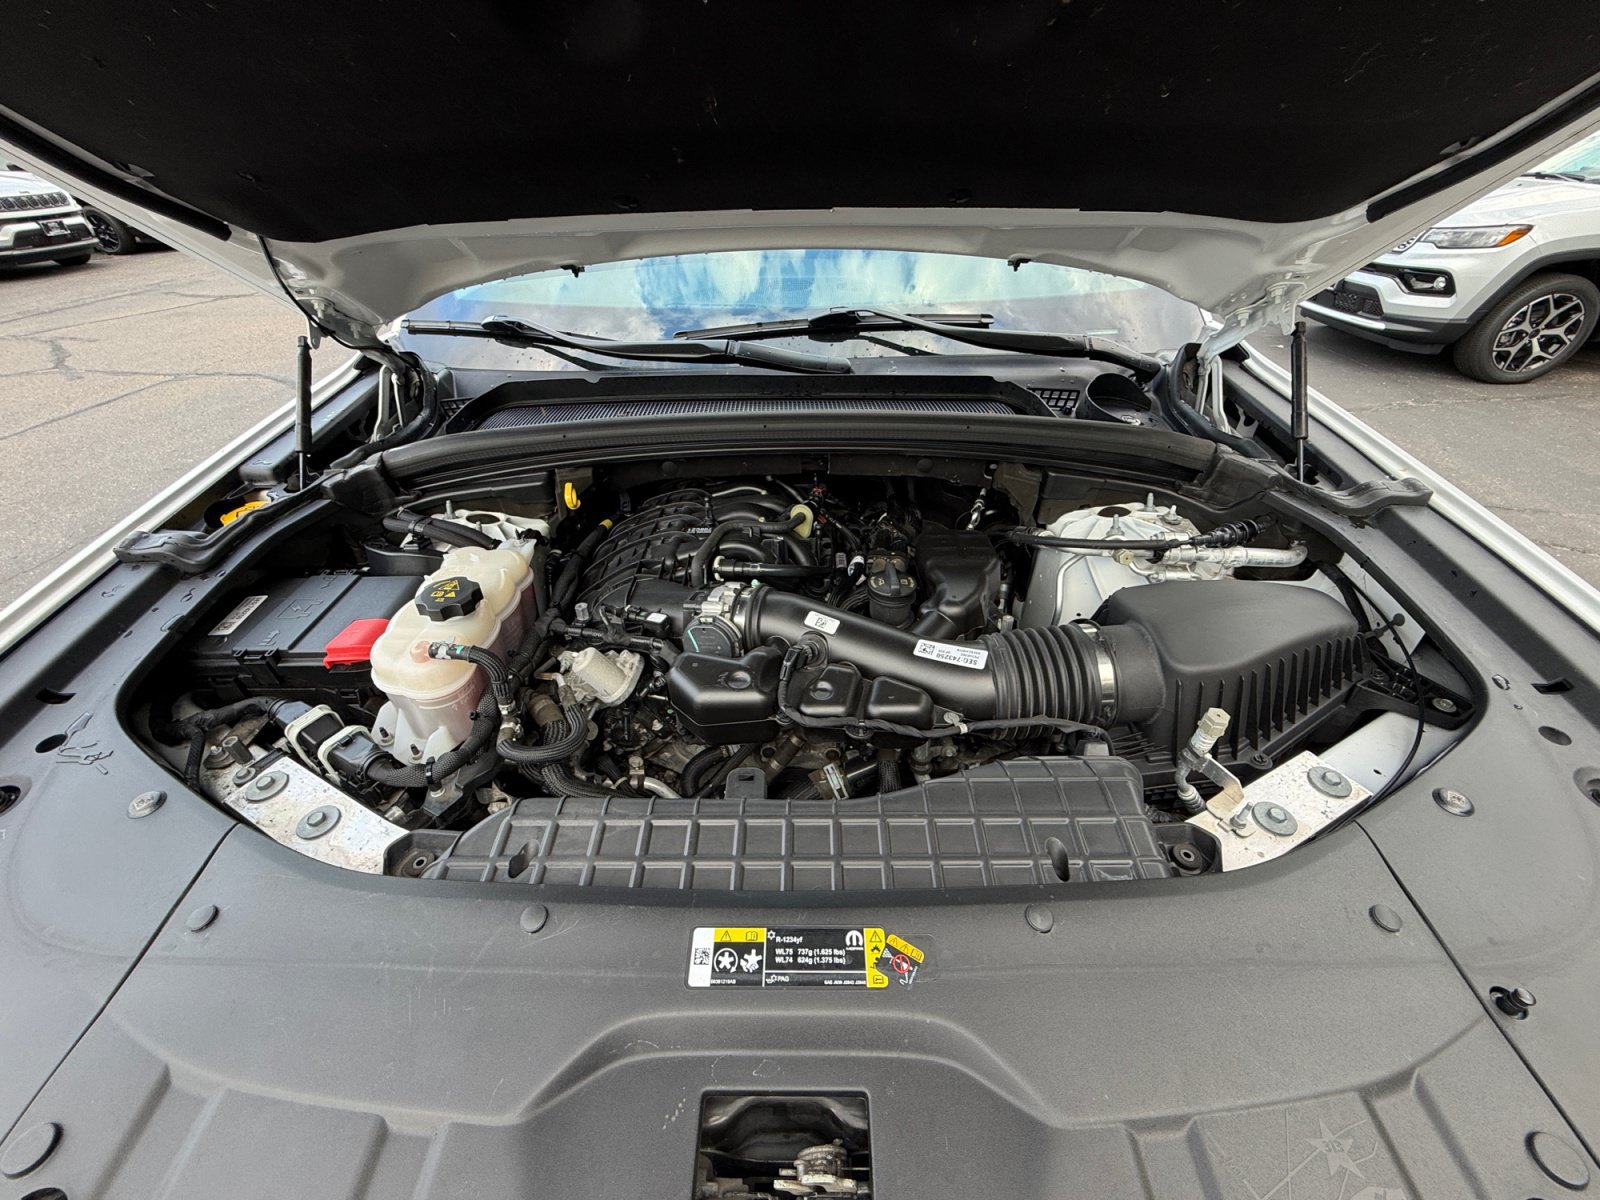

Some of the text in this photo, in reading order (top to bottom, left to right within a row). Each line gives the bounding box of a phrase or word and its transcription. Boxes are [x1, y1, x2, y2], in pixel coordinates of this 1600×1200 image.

[775, 936, 803, 944] R-1234yf
[797, 948, 813, 956] 737g
[833, 948, 846, 956] lbs)
[797, 956, 813, 965] 624g
[813, 956, 832, 965] (1.375
[833, 956, 846, 965] lbs)
